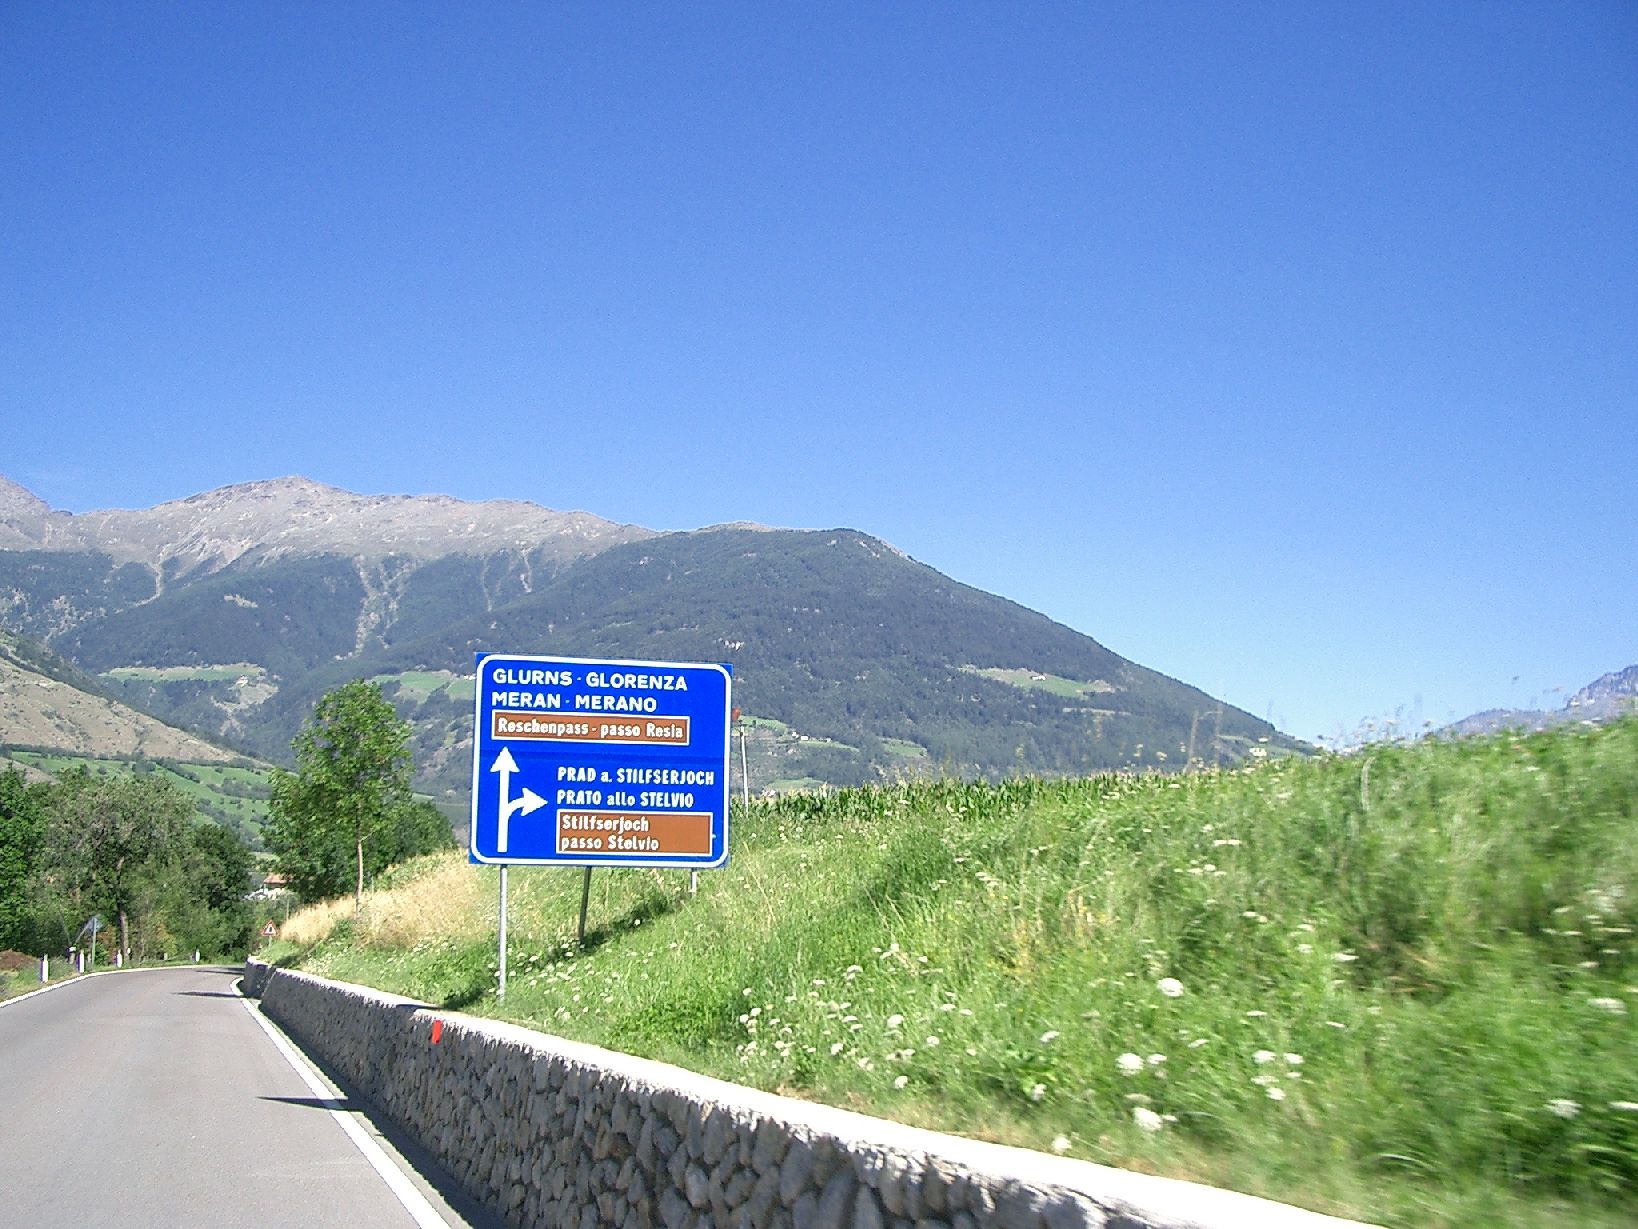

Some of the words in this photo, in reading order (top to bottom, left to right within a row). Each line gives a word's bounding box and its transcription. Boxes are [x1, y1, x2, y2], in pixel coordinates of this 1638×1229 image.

[492, 668, 573, 686] GLURNS
[586, 671, 688, 691] GLORENZA
[491, 691, 561, 709] MERAN
[575, 694, 657, 712] MERANO
[498, 717, 589, 736] Reschenpass
[600, 724, 641, 739] passo
[646, 722, 684, 738] Resia
[557, 766, 597, 783] PRAD
[600, 773, 613, 783] a.
[616, 768, 715, 786] STILFSERJOCH
[556, 789, 602, 806] PRATO
[606, 791, 636, 807] allo
[640, 792, 694, 808] STELVIO
[561, 814, 649, 834] Stilfserjoch
[561, 837, 602, 852] passo
[607, 835, 660, 851] Stelvio
